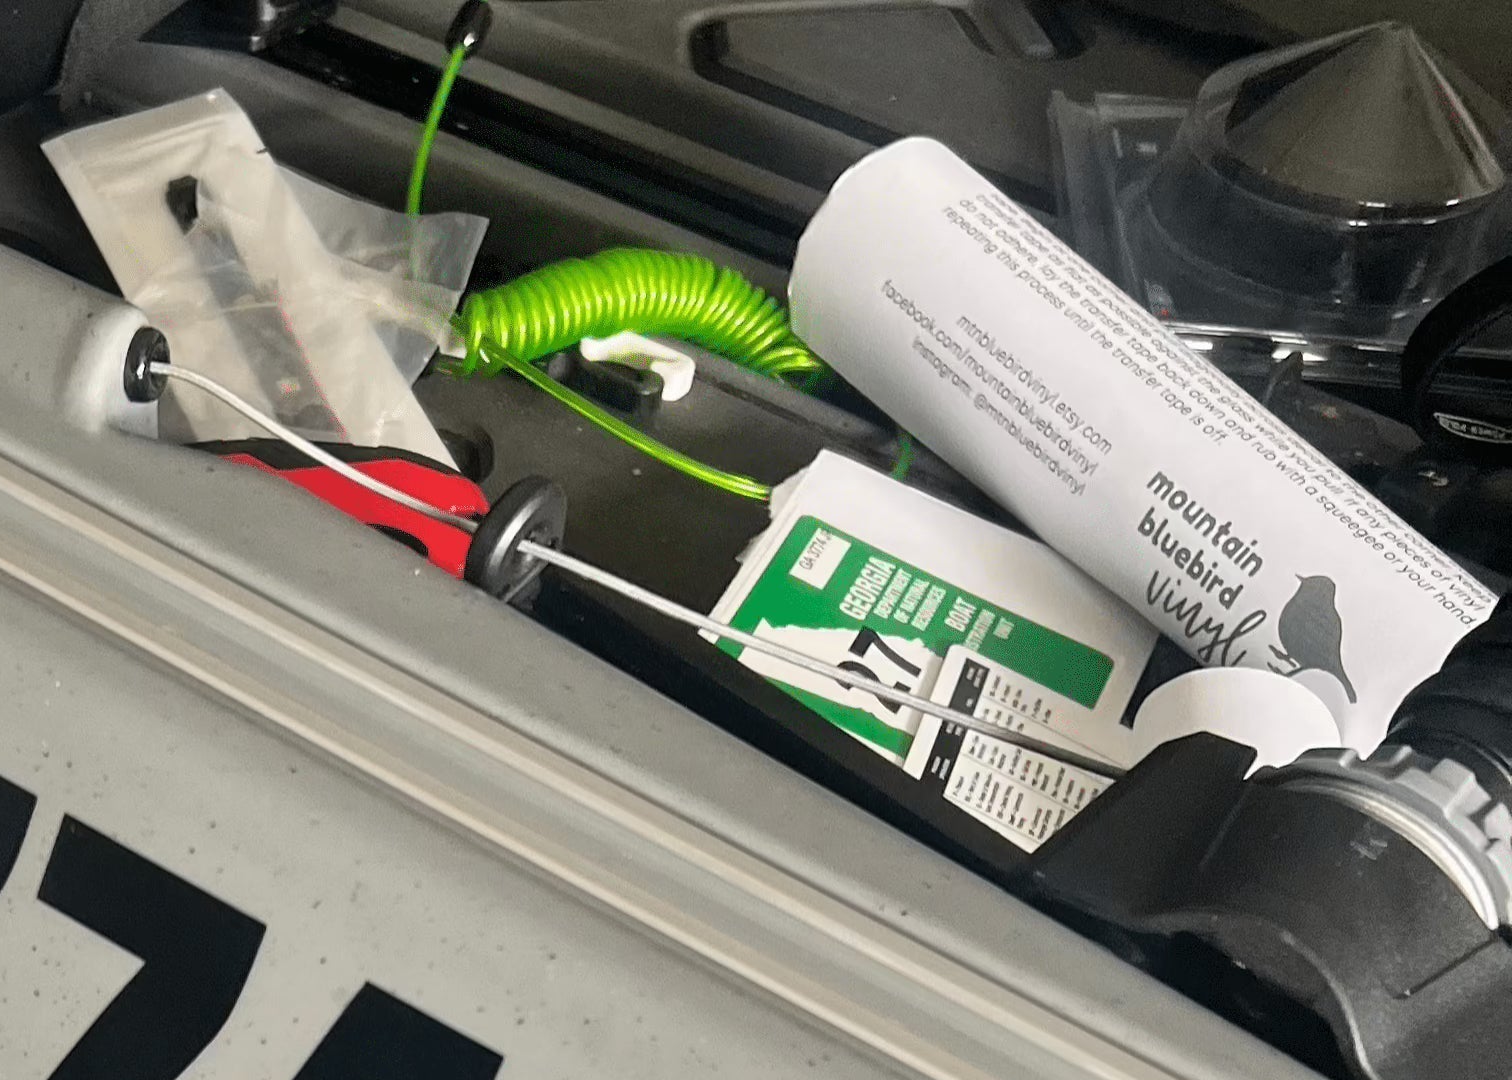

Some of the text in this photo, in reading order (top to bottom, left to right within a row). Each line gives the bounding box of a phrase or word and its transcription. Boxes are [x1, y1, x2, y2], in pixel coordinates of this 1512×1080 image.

[944, 207, 998, 254] repeating
[996, 250, 1020, 271] this
[1016, 270, 1065, 309] process
[1064, 307, 1096, 332] until
[1091, 330, 1113, 349] the
[1112, 348, 1163, 389] transfer
[1160, 388, 1192, 415] tape
[1190, 413, 1204, 425] is
[960, 200, 978, 213] do
[975, 212, 998, 230] not
[1040, 264, 1061, 281] lay
[1058, 281, 1081, 299] the
[1080, 298, 1129, 336] transfer
[1127, 337, 1158, 362] tape
[1156, 362, 1190, 390] back
[1189, 389, 1225, 419] down
[1224, 419, 1256, 441] and
[1252, 441, 1277, 461] rub
[1276, 461, 1305, 486] with
[1305, 486, 1318, 496] a
[1316, 496, 1384, 550] squeegee
[1384, 552, 1403, 563] or
[1396, 565, 1436, 590] your
[1098, 298, 1152, 337] possible
[1151, 339, 1200, 377] against
[1198, 377, 1220, 394] the
[1217, 396, 1255, 423] glass
[1255, 424, 1289, 451] while
[1286, 452, 1316, 472] you
[1356, 509, 1385, 528] any
[1380, 532, 1431, 568] pieces
[1431, 570, 1451, 581] of
[1449, 584, 1485, 611] vinyl
[1138, 506, 1243, 610] bluebird
[1147, 472, 1263, 577] mountain
[839, 557, 896, 620] GEORGIA
[944, 596, 977, 632] BOAT
